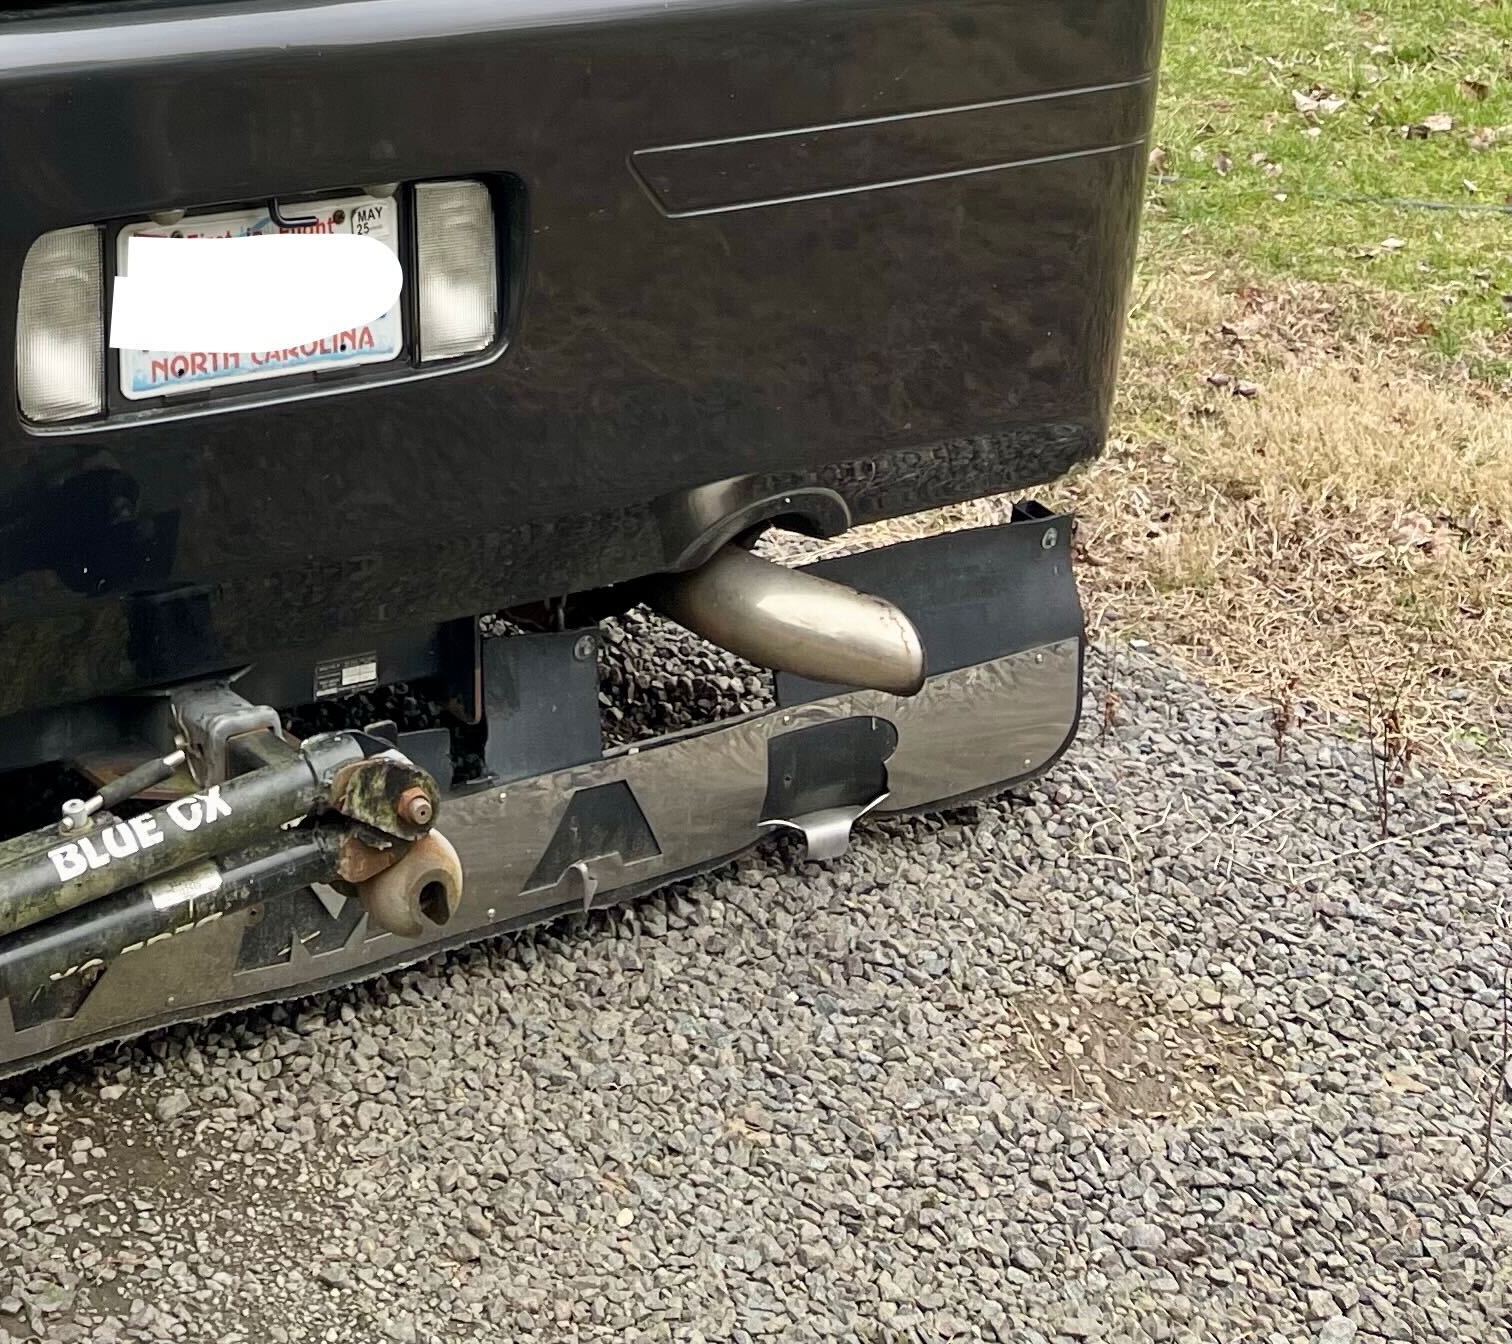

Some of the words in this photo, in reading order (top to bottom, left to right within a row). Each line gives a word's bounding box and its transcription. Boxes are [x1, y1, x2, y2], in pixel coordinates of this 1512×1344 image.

[357, 207, 383, 223] MAY
[356, 222, 370, 237] 25
[48, 813, 165, 882] BLUE
[167, 785, 233, 832] OX
